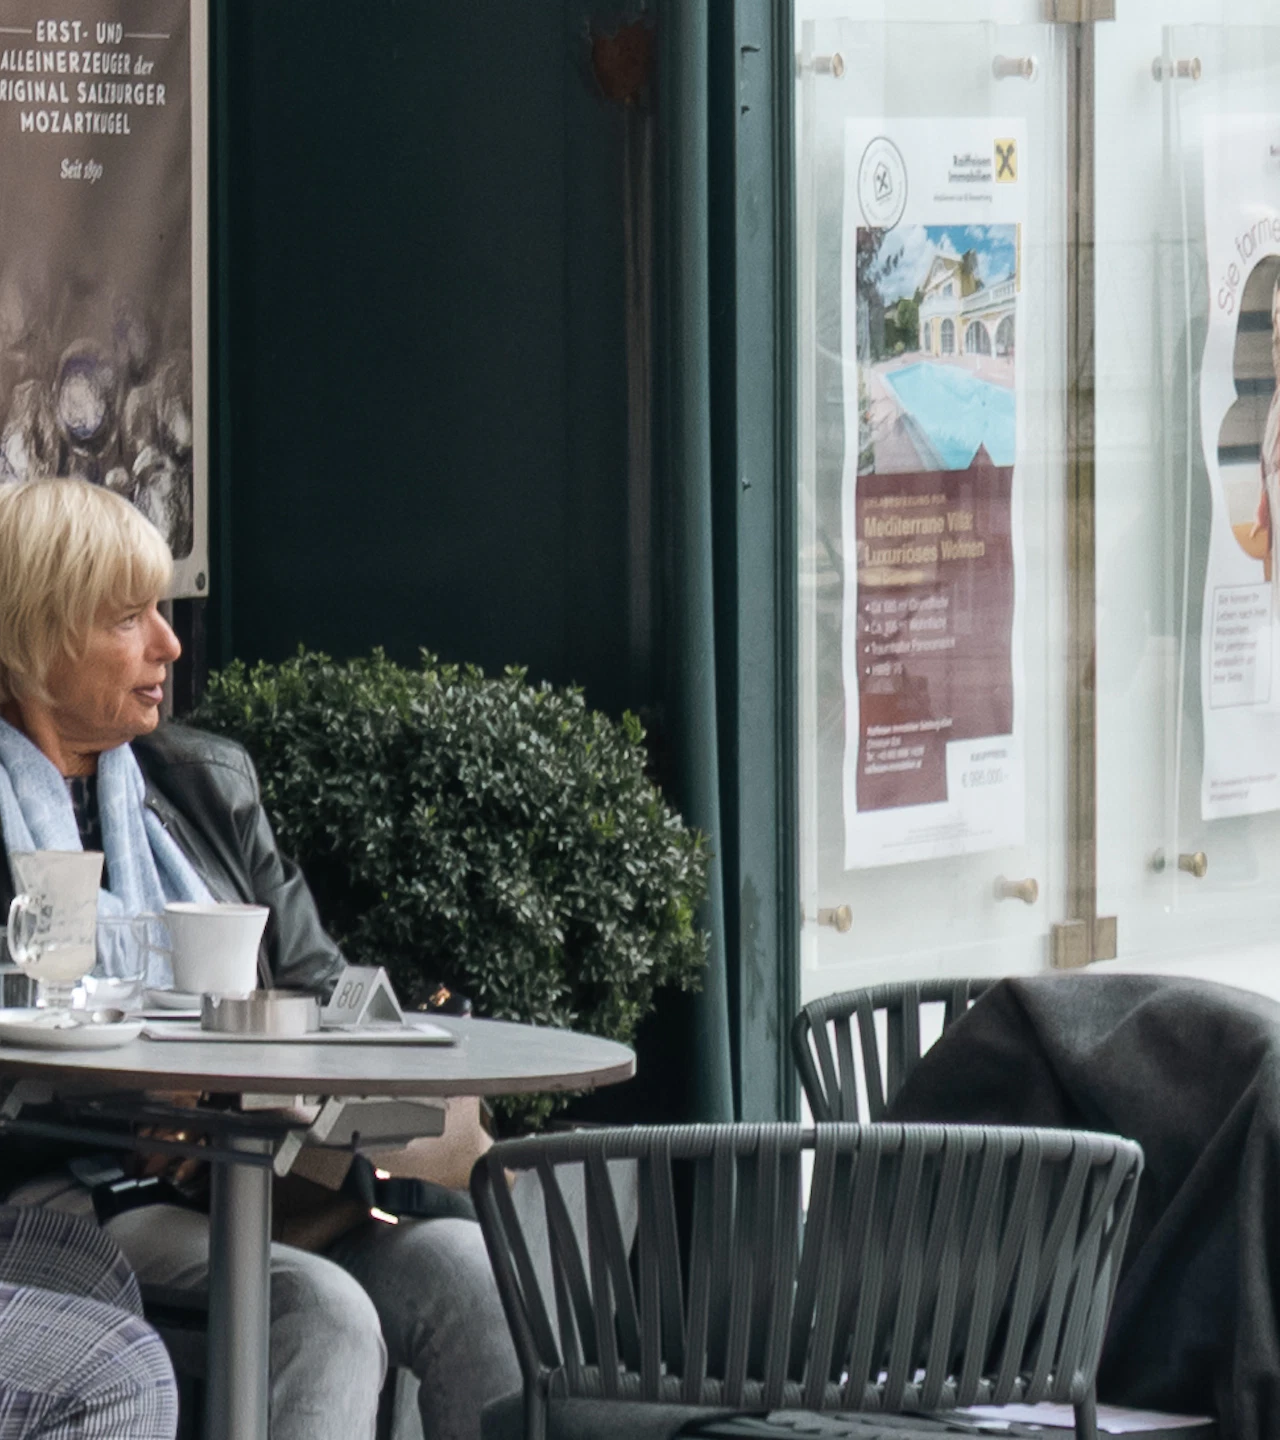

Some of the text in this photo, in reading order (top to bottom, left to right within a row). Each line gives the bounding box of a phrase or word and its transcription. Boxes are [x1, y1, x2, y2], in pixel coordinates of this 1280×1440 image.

[36, 20, 123, 45] ERST- UND
[0, 49, 154, 75] ALLEINERZEUGER der
[77, 81, 166, 106] SALZBURGER
[20, 110, 131, 135] MOZARTKUGEL
[60, 158, 82, 180] Seit
[1218, 260, 1241, 316] Sie
[337, 981, 364, 1009] 80
